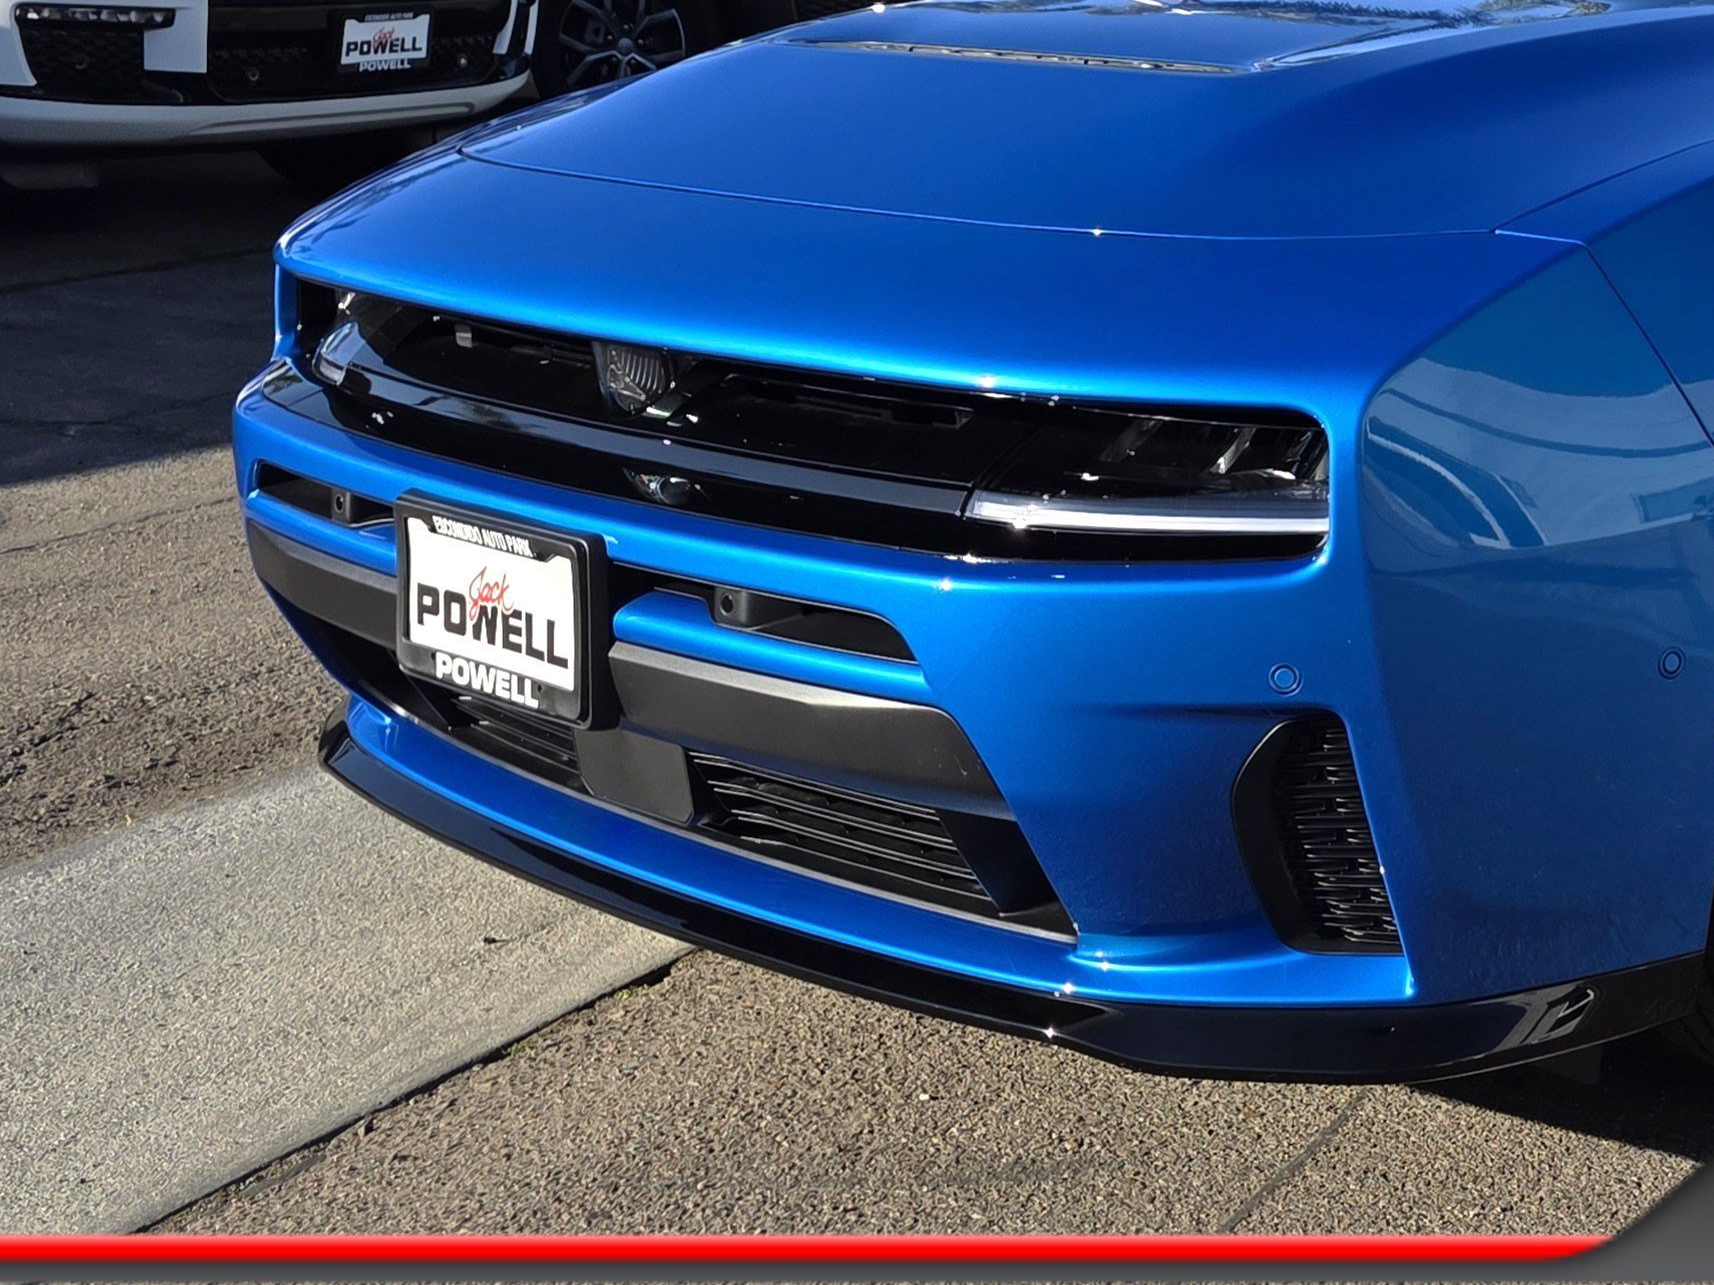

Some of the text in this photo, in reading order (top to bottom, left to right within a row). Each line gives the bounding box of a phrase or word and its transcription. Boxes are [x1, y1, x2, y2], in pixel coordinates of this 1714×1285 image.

[345, 36, 423, 57] POWELL
[359, 59, 412, 72] POWELL
[481, 528, 508, 551] AUTO
[504, 534, 534, 558] PARK
[468, 566, 515, 621] Jack
[416, 582, 570, 670] POWELL
[434, 652, 540, 709] POWELL
